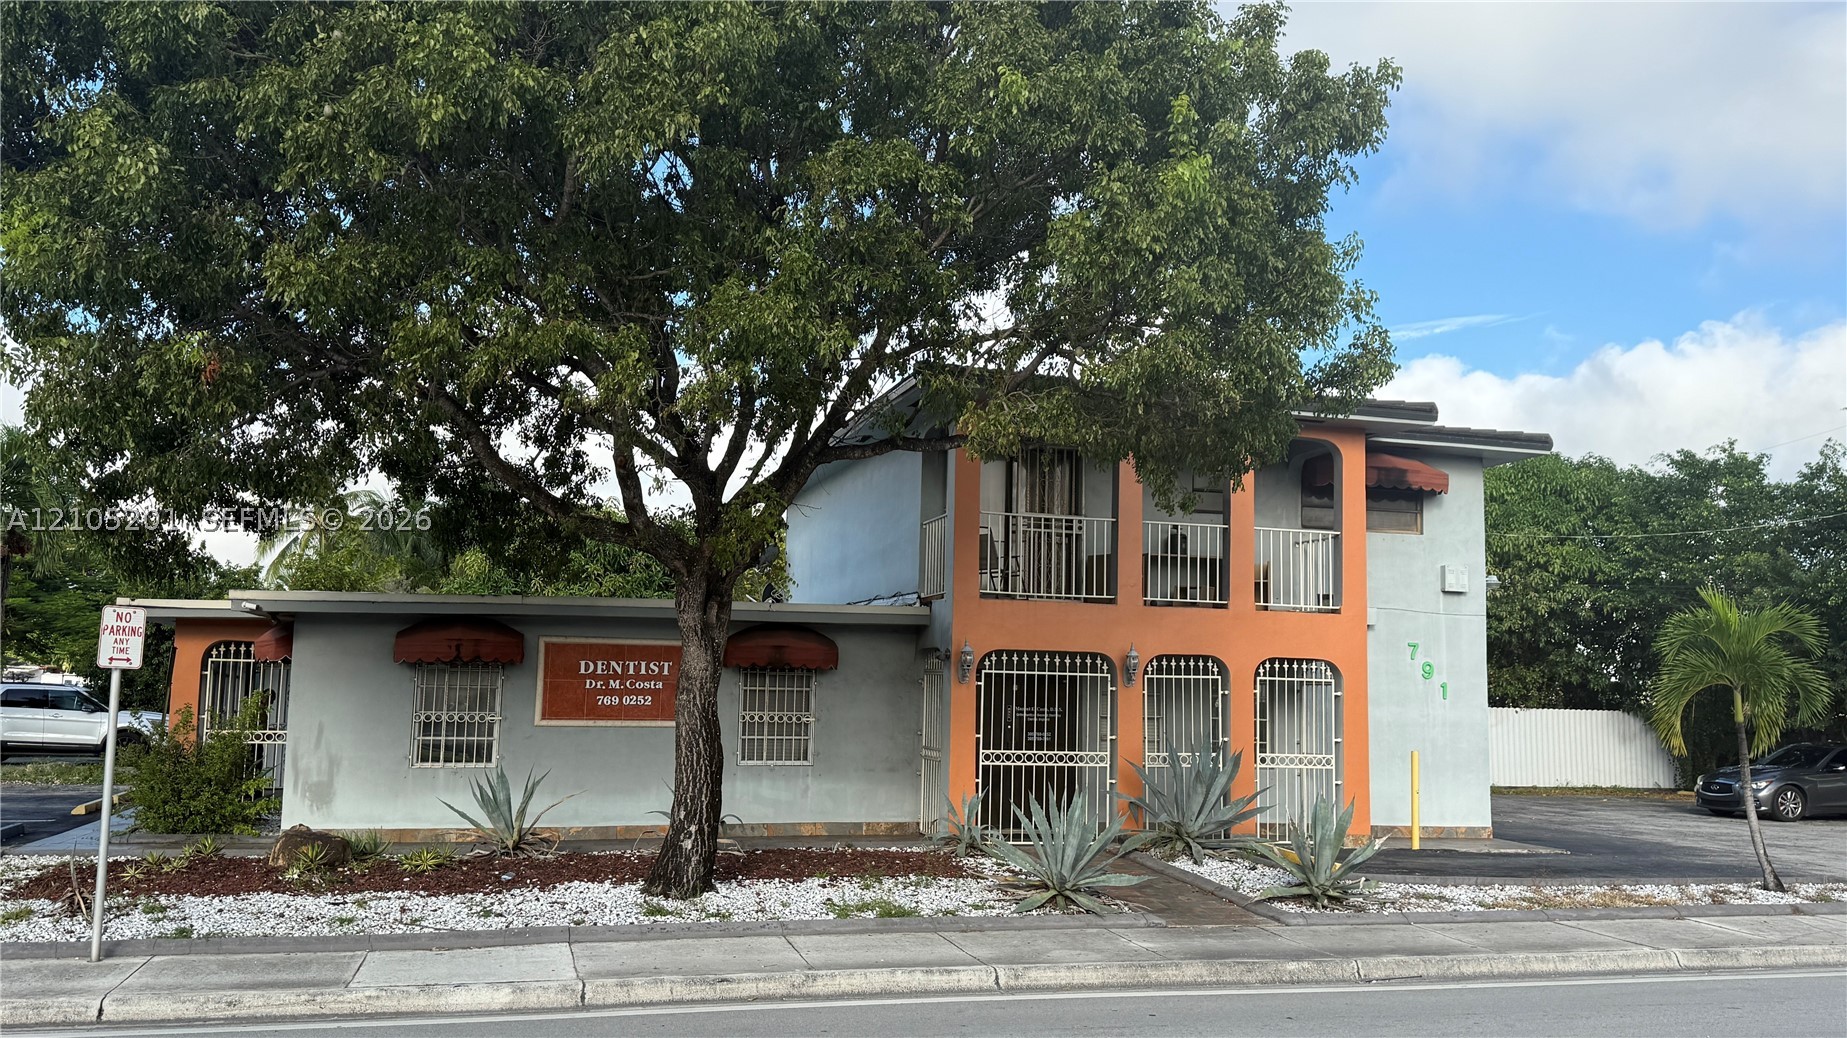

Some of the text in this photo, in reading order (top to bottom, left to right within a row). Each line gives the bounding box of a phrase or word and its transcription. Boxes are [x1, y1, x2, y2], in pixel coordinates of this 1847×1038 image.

[115, 611, 132, 623] NO
[102, 624, 143, 637] PARKING
[112, 646, 130, 655] TIME
[578, 660, 673, 676] DENTIST
[584, 679, 663, 689] Dr. M. Costa
[596, 695, 652, 705] 769 0252
